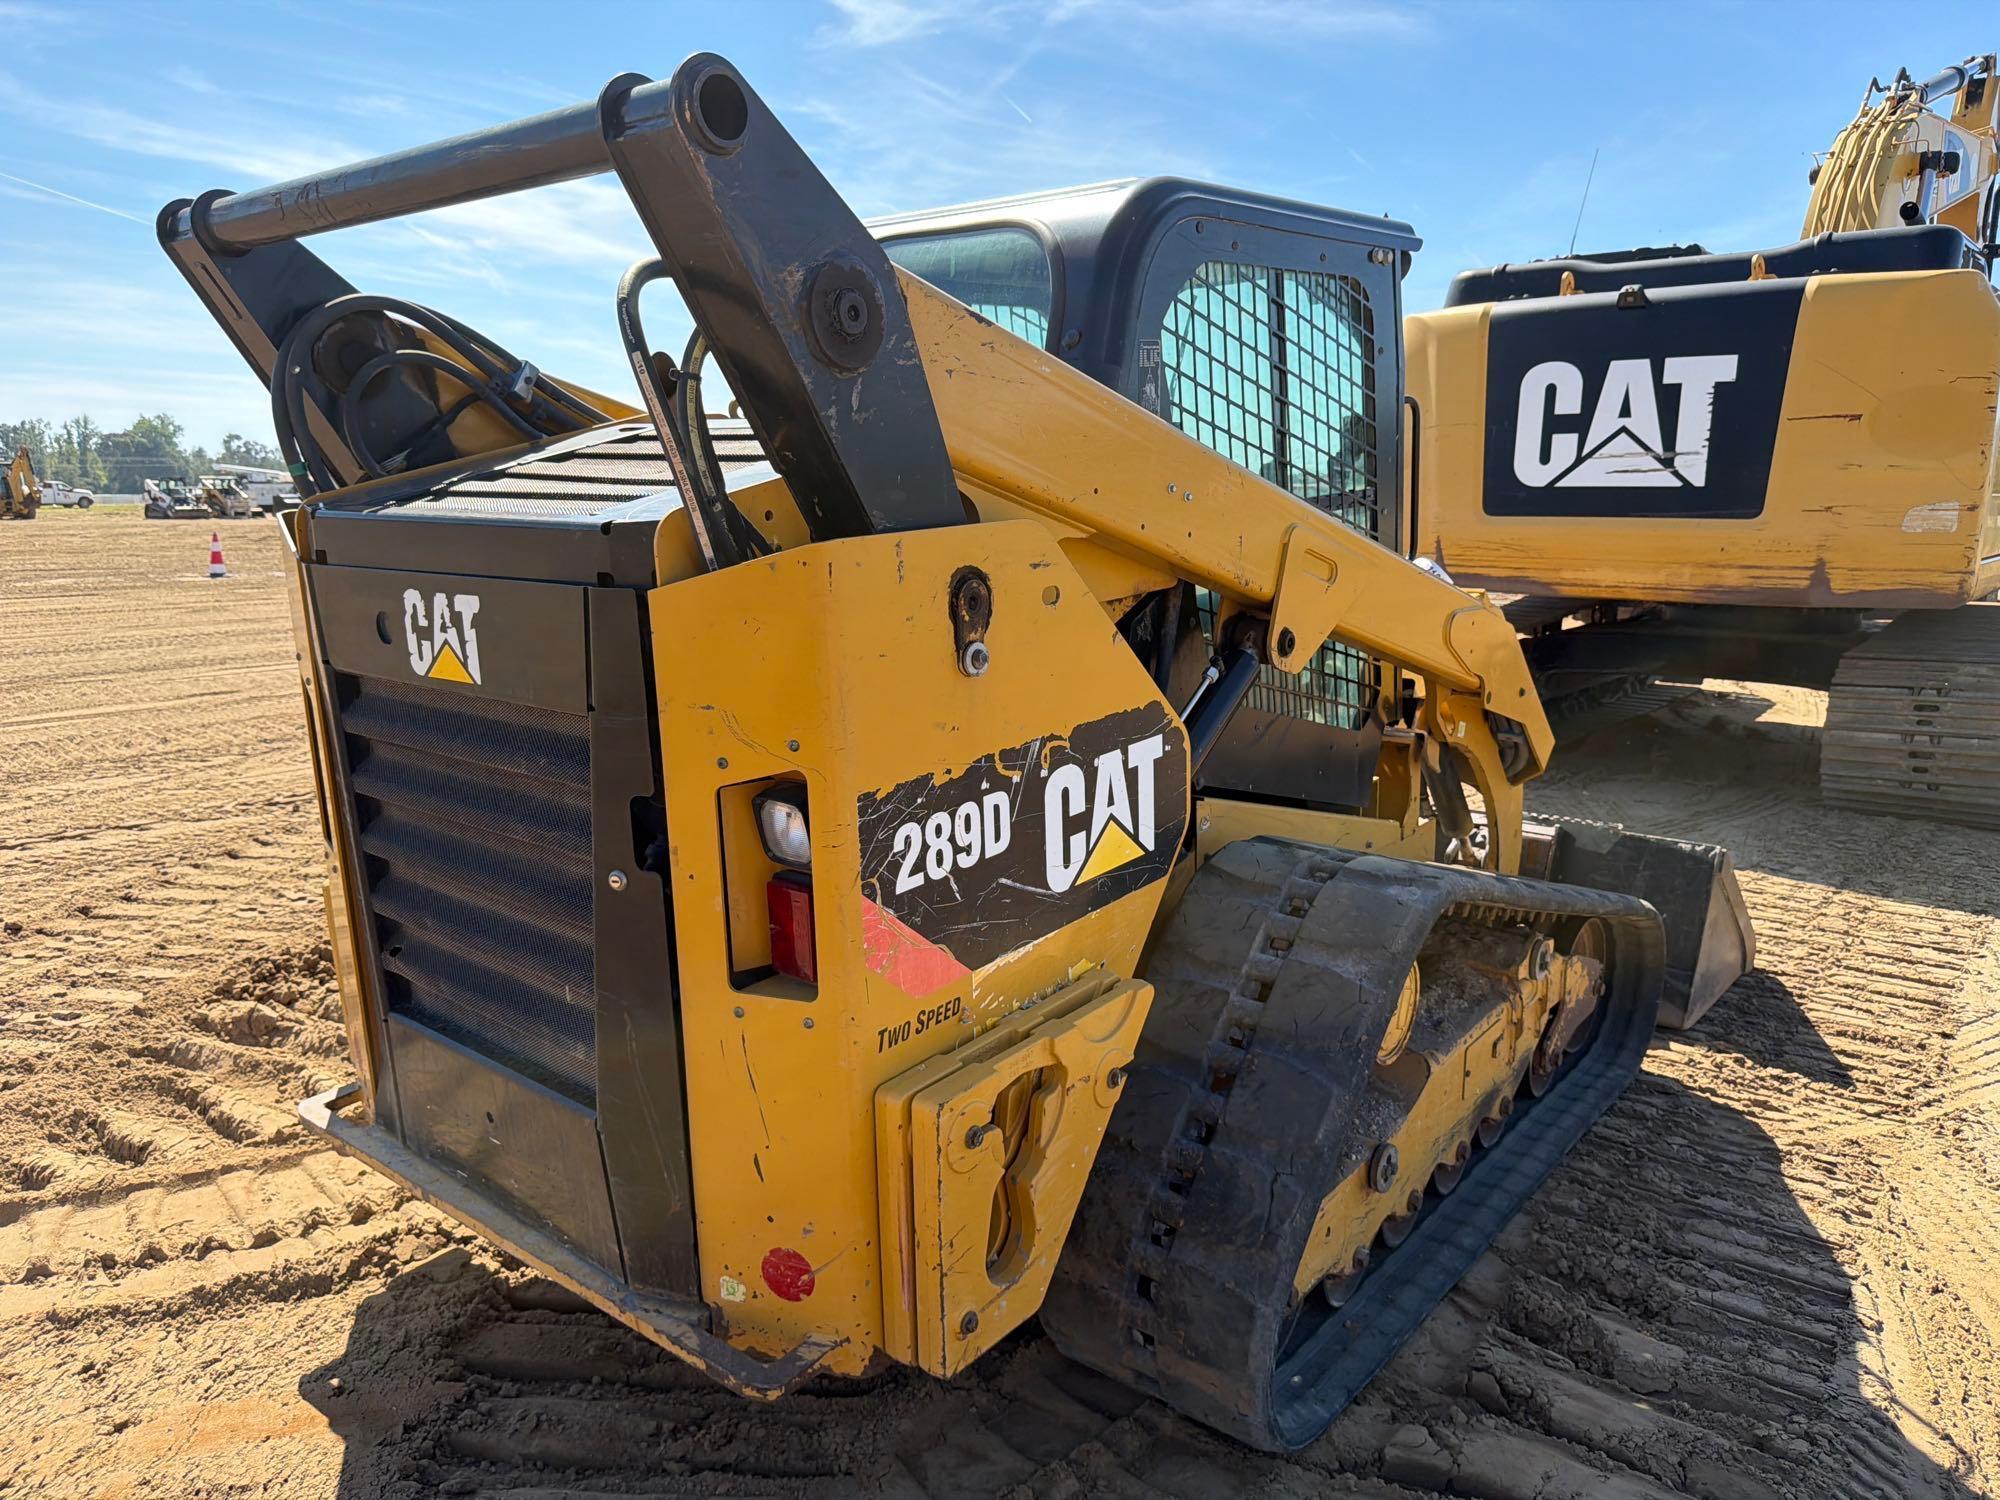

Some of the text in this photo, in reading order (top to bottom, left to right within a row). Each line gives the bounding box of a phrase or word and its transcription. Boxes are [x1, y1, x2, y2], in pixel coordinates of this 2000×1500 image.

[1513, 353, 1739, 488] CAT
[402, 588, 482, 686] CAT
[893, 734, 1164, 895] 289D CAT
